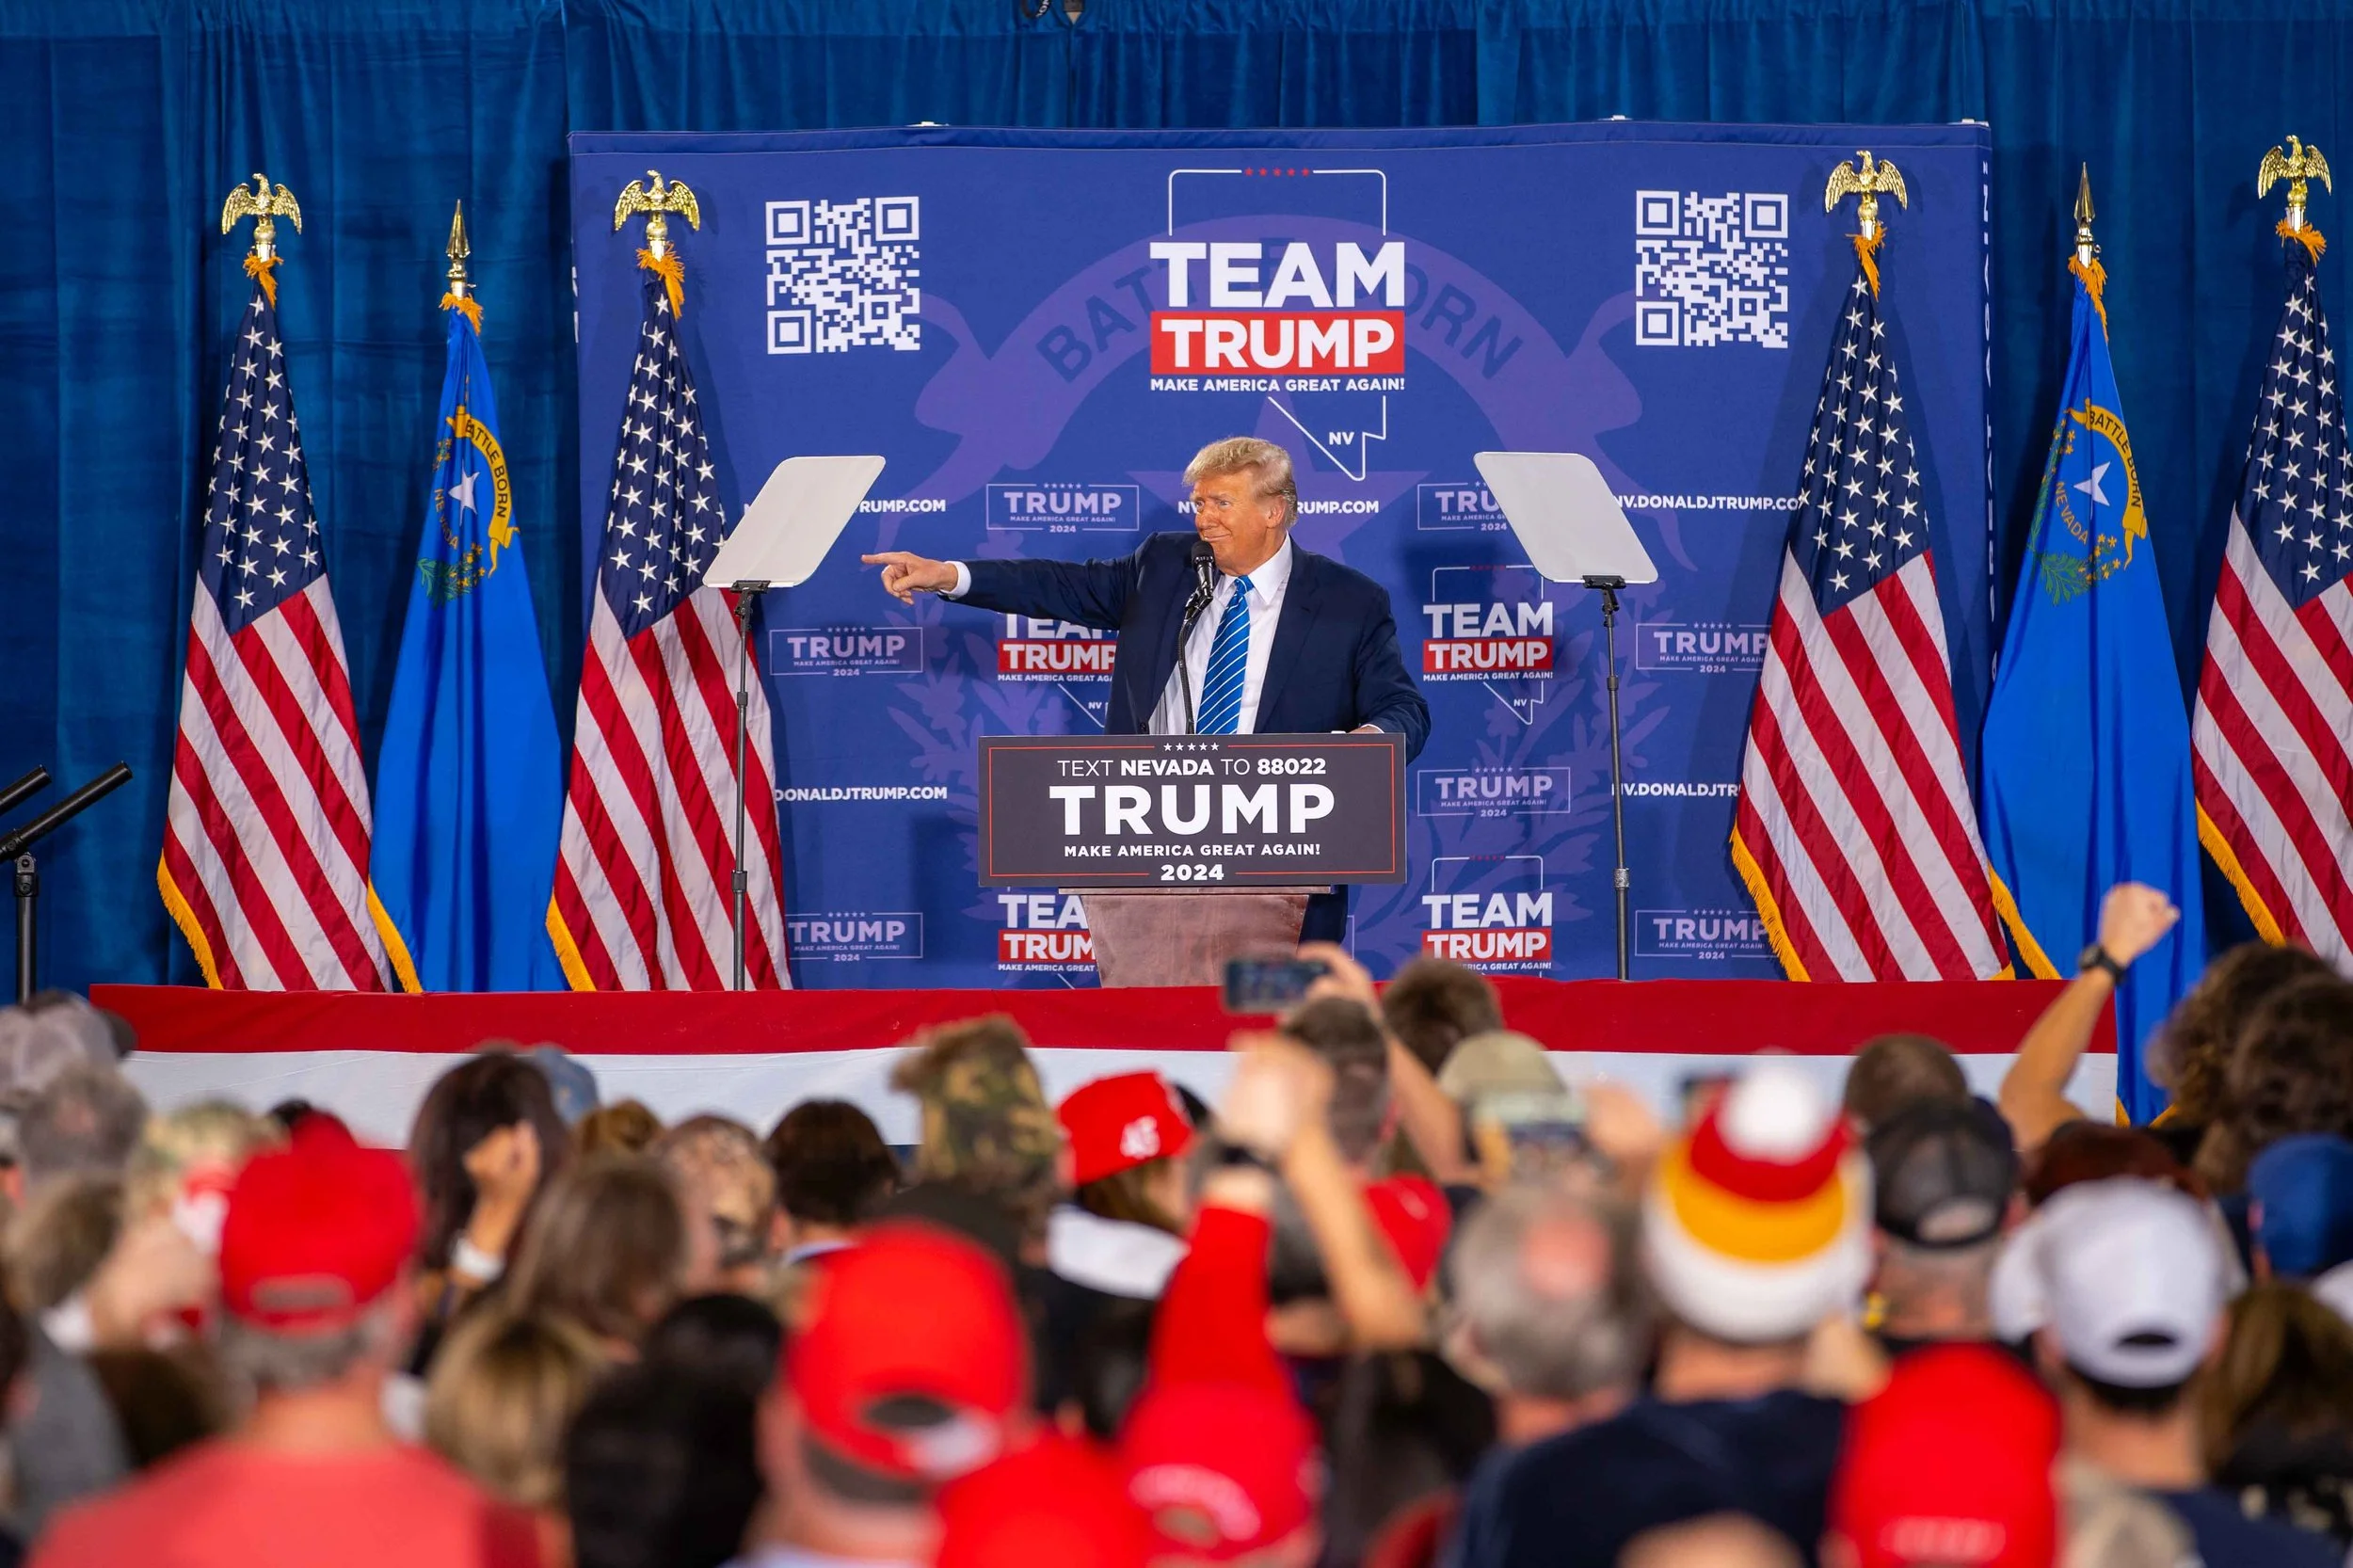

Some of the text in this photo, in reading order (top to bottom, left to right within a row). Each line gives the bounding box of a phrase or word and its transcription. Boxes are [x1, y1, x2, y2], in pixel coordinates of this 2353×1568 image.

[1150, 242, 1405, 308] TEAM
[1160, 318, 1395, 369] TRUMP
[1150, 377, 1405, 392] MAKE AMERICA GREAT AGAIN!
[1328, 431, 1354, 445] NV
[2089, 410, 2128, 454] BATTLE
[494, 465, 508, 519] BORN
[1003, 491, 1122, 514] TRUMP
[2056, 481, 2089, 546] NEVADA
[1481, 522, 1507, 532] 2024
[1423, 601, 1553, 638] TEAM
[788, 635, 905, 659] TRUMP
[1428, 641, 1548, 669] TRUMP
[1654, 632, 1769, 655] TRUMP
[833, 668, 860, 677] 2024
[1423, 671, 1553, 682] MAKE AMERICA GREAT AGAIN!
[1699, 664, 1726, 674] 2024
[1513, 698, 1528, 707] NV
[1057, 758, 1327, 777] TEXT NEVADA TO 88022
[1434, 775, 1554, 799] TRUMP
[1048, 783, 1336, 836] TRUMP
[1480, 808, 1508, 818] 2024
[1064, 843, 1321, 858] MAKE AMERICA GREAT AGAIN!
[1160, 863, 1225, 882] 2024
[1422, 892, 1553, 929] TEAM
[787, 920, 906, 943] TRUMP
[1653, 918, 1769, 941] TRUMP
[1427, 932, 1547, 959] TRUMP
[1698, 951, 1725, 960] 2024
[833, 953, 861, 962] 2024
[1024, 964, 1064, 972] AMERICA
[1490, 962, 1519, 970] GREAT
[1520, 961, 1552, 970] AGAIN!
